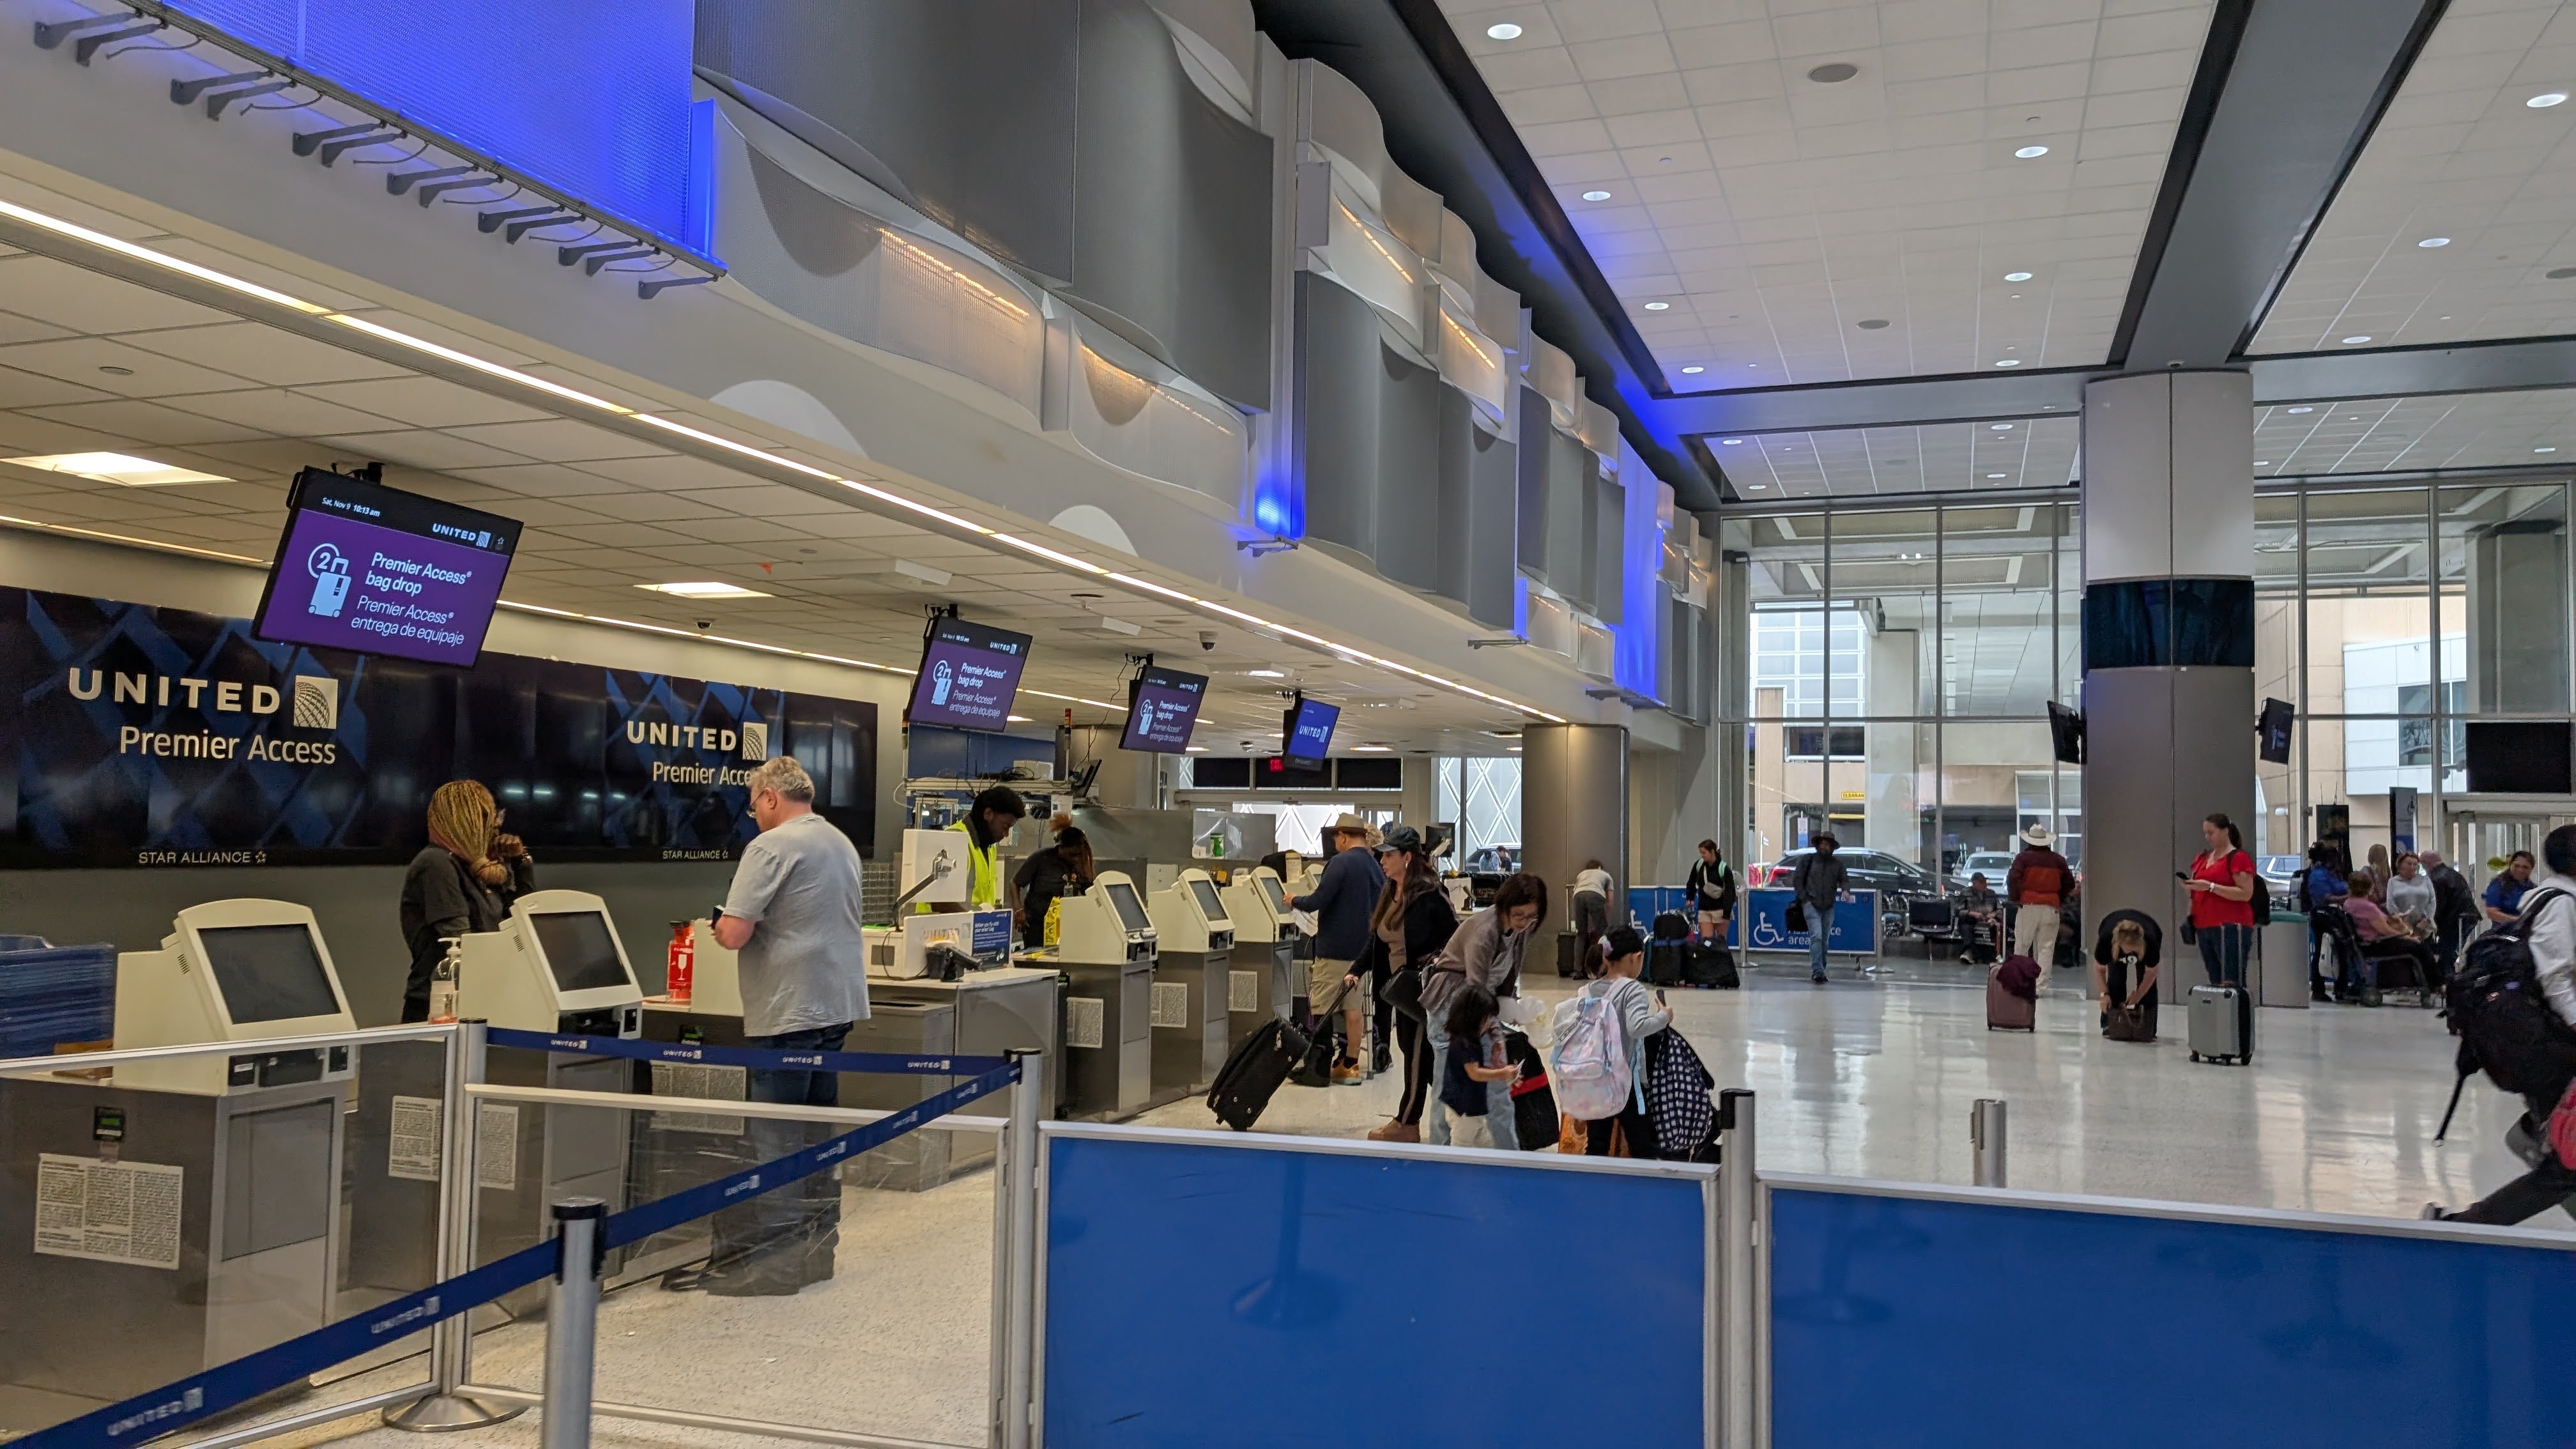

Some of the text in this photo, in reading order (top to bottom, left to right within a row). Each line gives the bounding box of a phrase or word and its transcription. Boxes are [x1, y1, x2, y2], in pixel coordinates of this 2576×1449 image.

[334, 501, 346, 510] Nov
[353, 504, 370, 516] 10:13
[370, 509, 381, 518] am
[432, 523, 477, 542] UNITED
[317, 552, 331, 569] 2
[371, 552, 422, 575] Premier
[365, 570, 422, 597] bag drop
[356, 595, 406, 617] Premier
[351, 616, 464, 647] entrega de equipaje
[990, 641, 1011, 651] UNITED
[937, 665, 944, 677] 2
[961, 662, 984, 675] Premier
[69, 666, 280, 714] UNITED
[958, 675, 983, 689] bag drop
[953, 689, 974, 701] Premier
[949, 703, 1000, 719] entrega de equipaje
[627, 720, 737, 751] UNITED
[1299, 724, 1321, 738] UNITED
[119, 725, 337, 765] Premier Access
[653, 761, 752, 786] Premier Acce
[138, 851, 252, 864] STAR ALLIANCE
[663, 850, 721, 859] STAR ALLIANCE
[1788, 935, 1811, 945] area
[551, 1039, 578, 1048] UNITED
[663, 1050, 693, 1058] UNITED
[107, 1400, 183, 1437] UNITED
